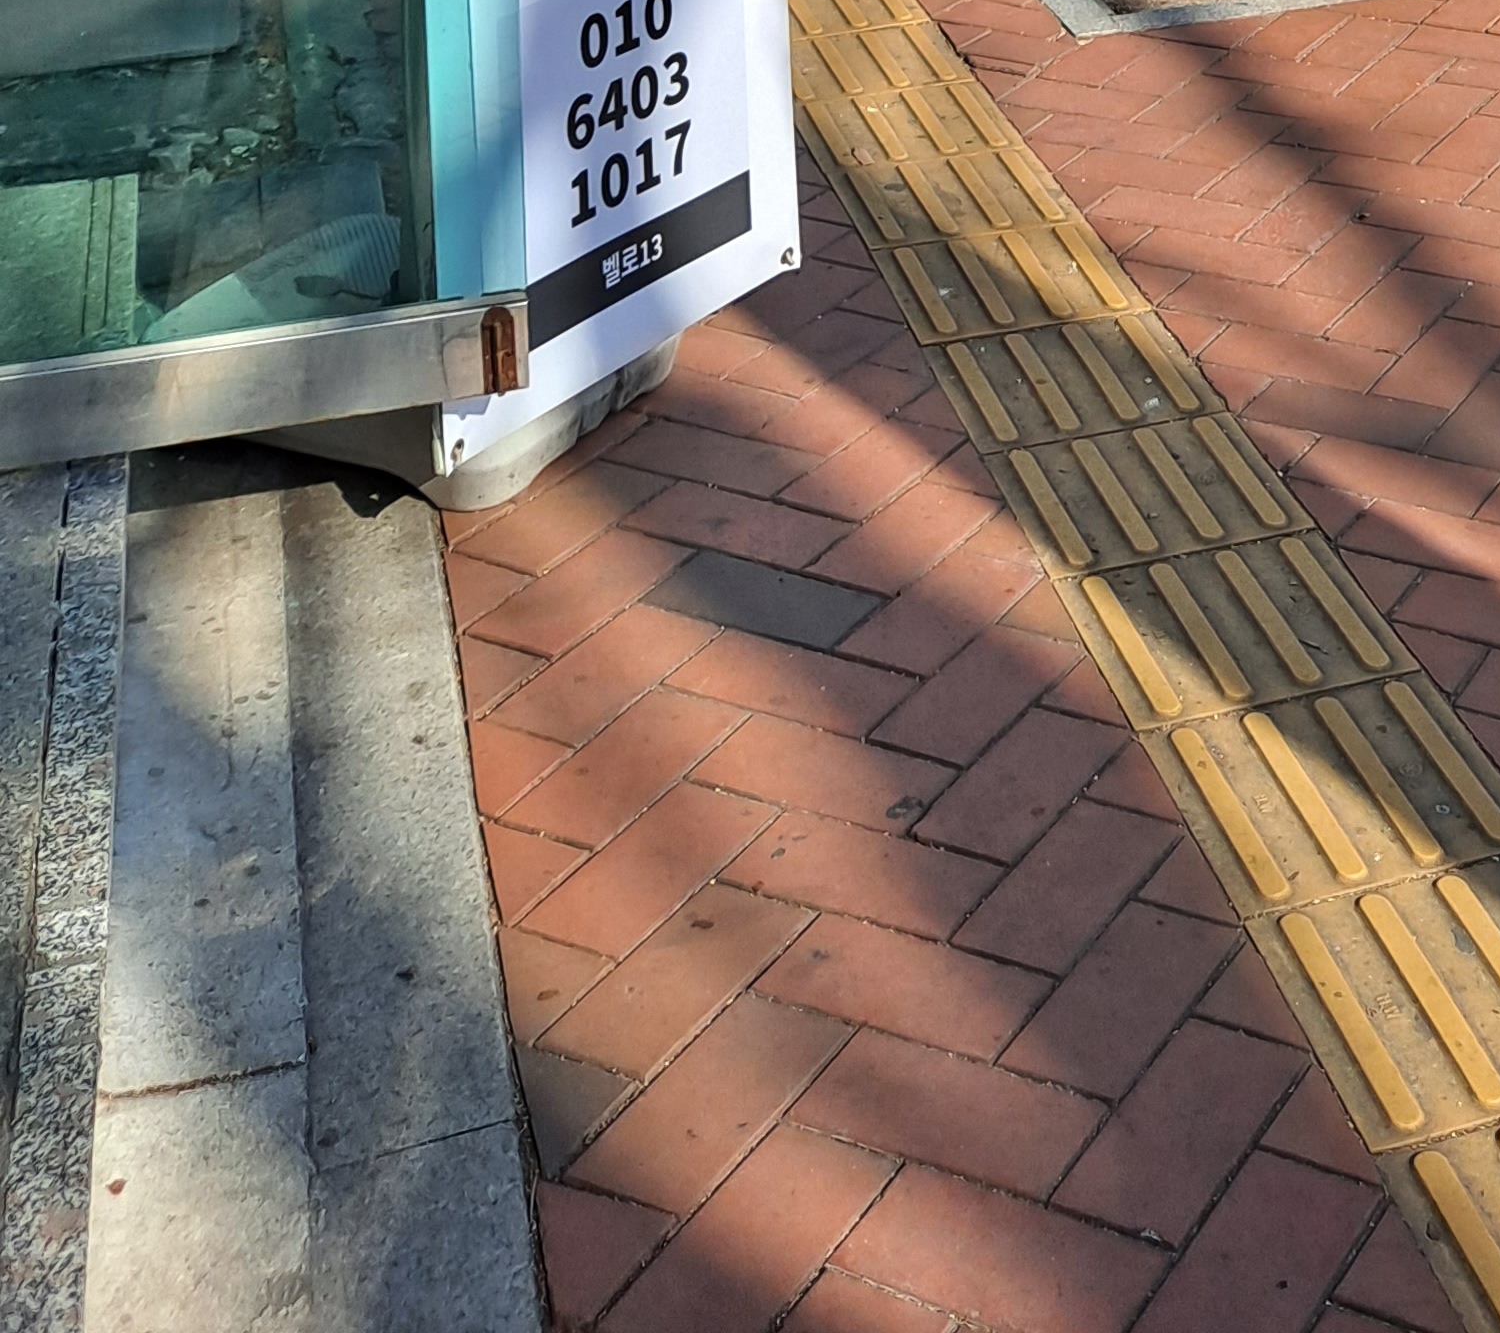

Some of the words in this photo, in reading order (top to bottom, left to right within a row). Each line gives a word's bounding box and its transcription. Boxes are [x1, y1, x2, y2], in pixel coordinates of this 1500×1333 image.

[566, 51, 690, 151] 6403
[571, 119, 692, 229] 1017
[601, 233, 663, 290] 벨로13
